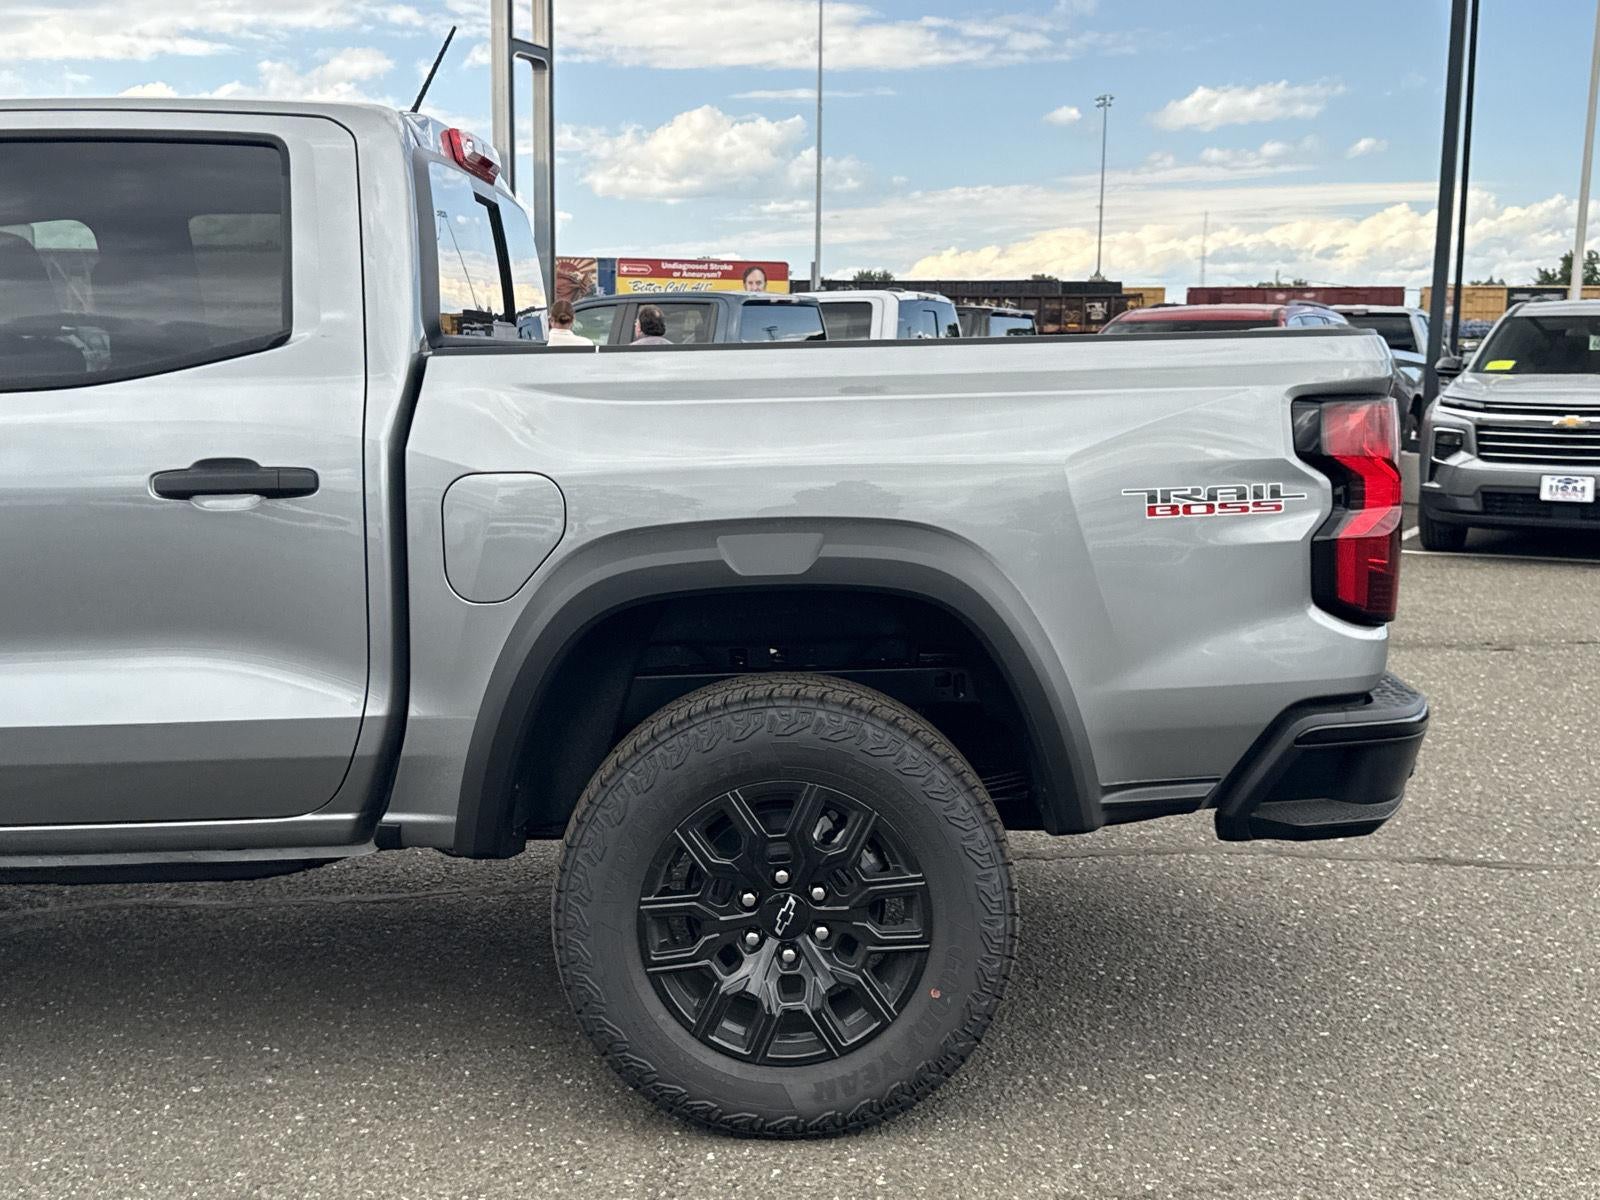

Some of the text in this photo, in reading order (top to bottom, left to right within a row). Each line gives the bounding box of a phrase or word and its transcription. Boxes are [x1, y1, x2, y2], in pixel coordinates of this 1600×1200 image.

[661, 261, 734, 271] Undiagnosed Stroke
[665, 281, 687, 292] Call
[1122, 482, 1307, 504] TRAIL
[1146, 500, 1284, 519] BOSS
